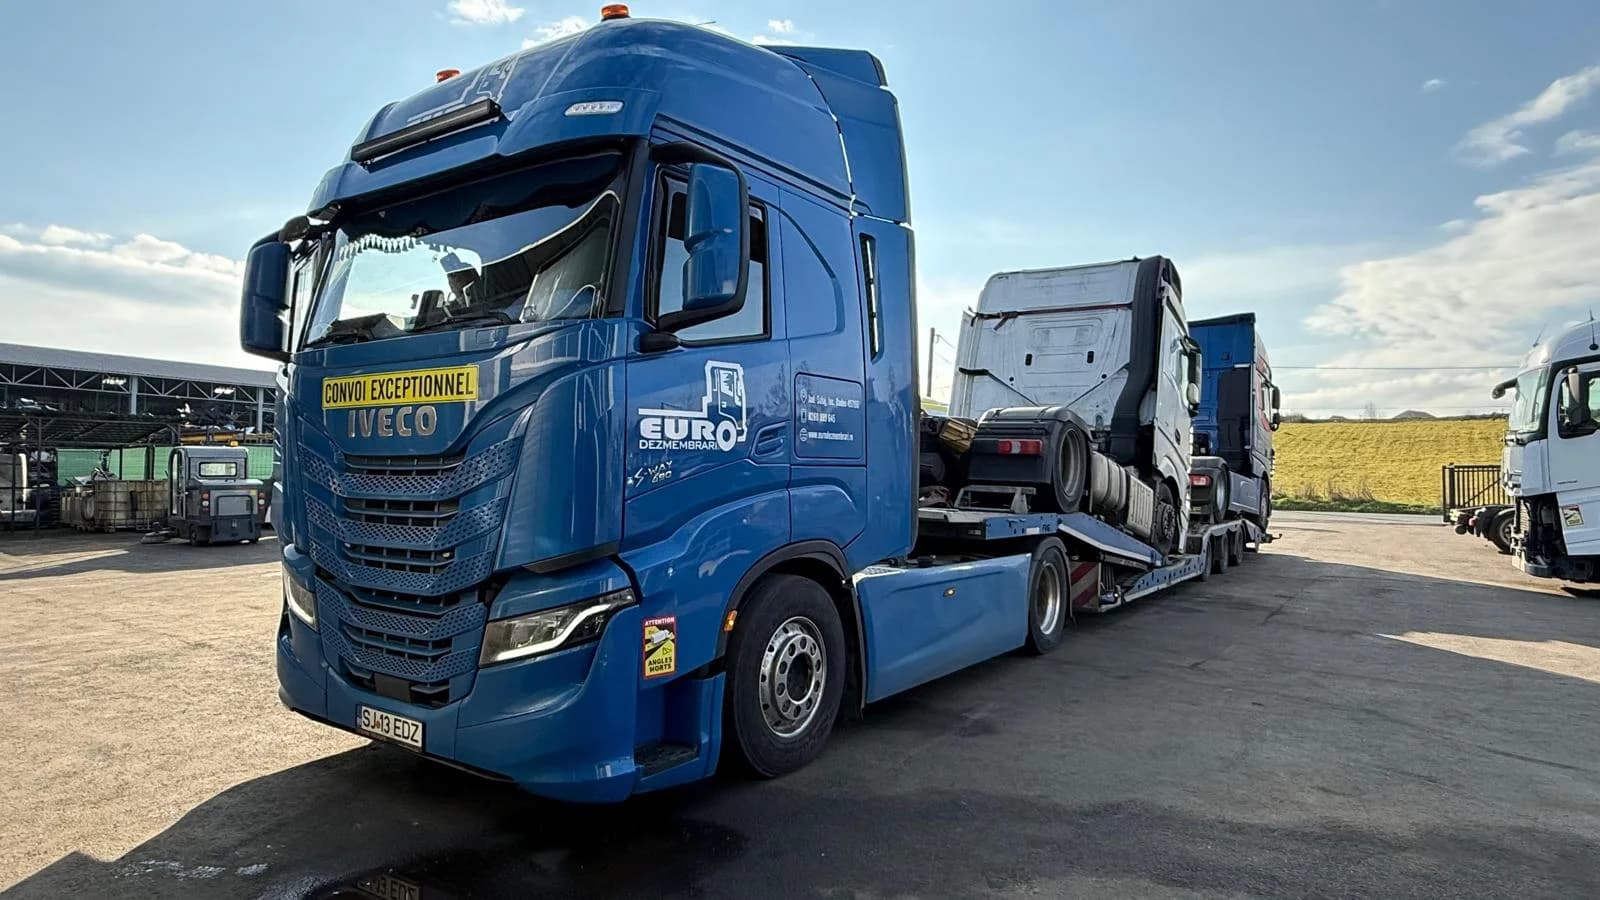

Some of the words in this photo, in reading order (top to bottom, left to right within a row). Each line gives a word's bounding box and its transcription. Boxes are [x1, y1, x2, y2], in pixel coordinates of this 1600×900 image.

[325, 380, 367, 403] CONVOI
[371, 372, 474, 401] EXCEPTIONNEL
[348, 405, 437, 438] IVECO
[639, 439, 718, 450] DEZMEMBRARI
[640, 418, 737, 451] EURO
[645, 617, 675, 626] ATTENTION
[648, 656, 672, 666] ANGLES
[649, 664, 671, 673] MORTS
[362, 709, 377, 729] SJ
[380, 714, 390, 734] 13
[393, 718, 419, 743] EDZ
